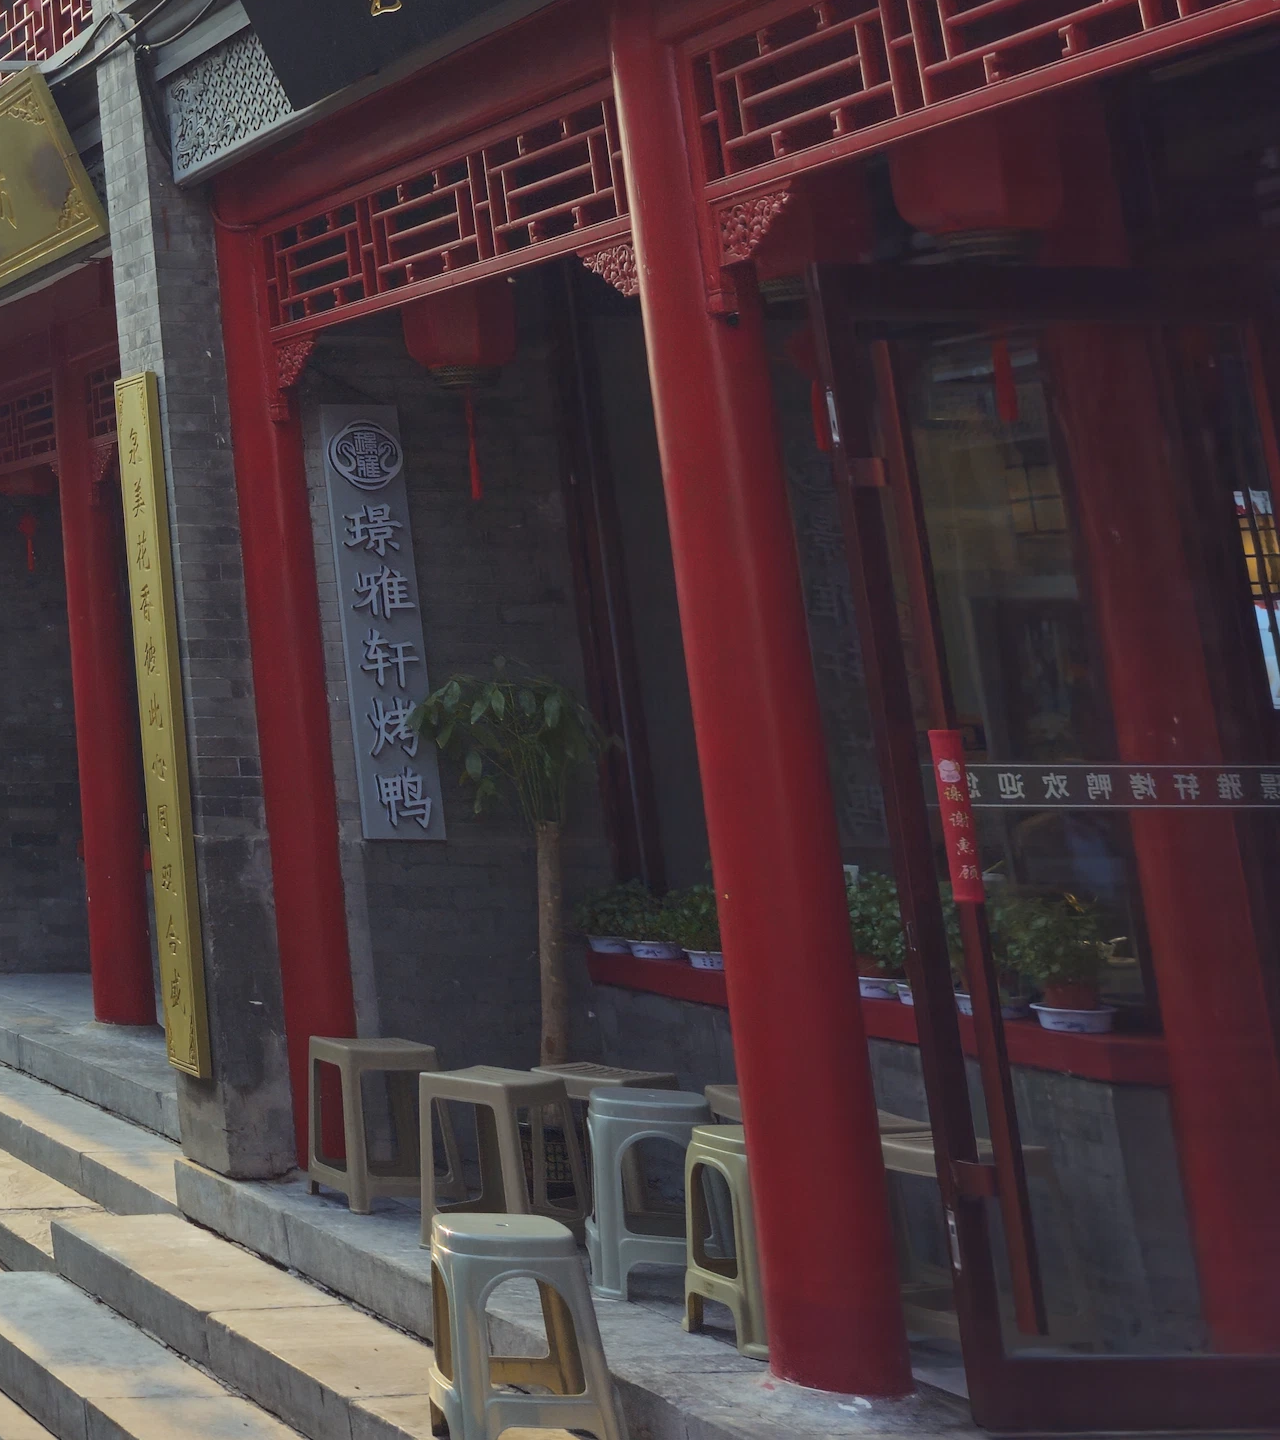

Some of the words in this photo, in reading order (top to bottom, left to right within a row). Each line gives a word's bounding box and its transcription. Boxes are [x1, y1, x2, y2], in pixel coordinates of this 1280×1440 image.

[342, 502, 434, 831] 璟雅轩烤鸭
[944, 784, 980, 881] 谢谢惠顾
